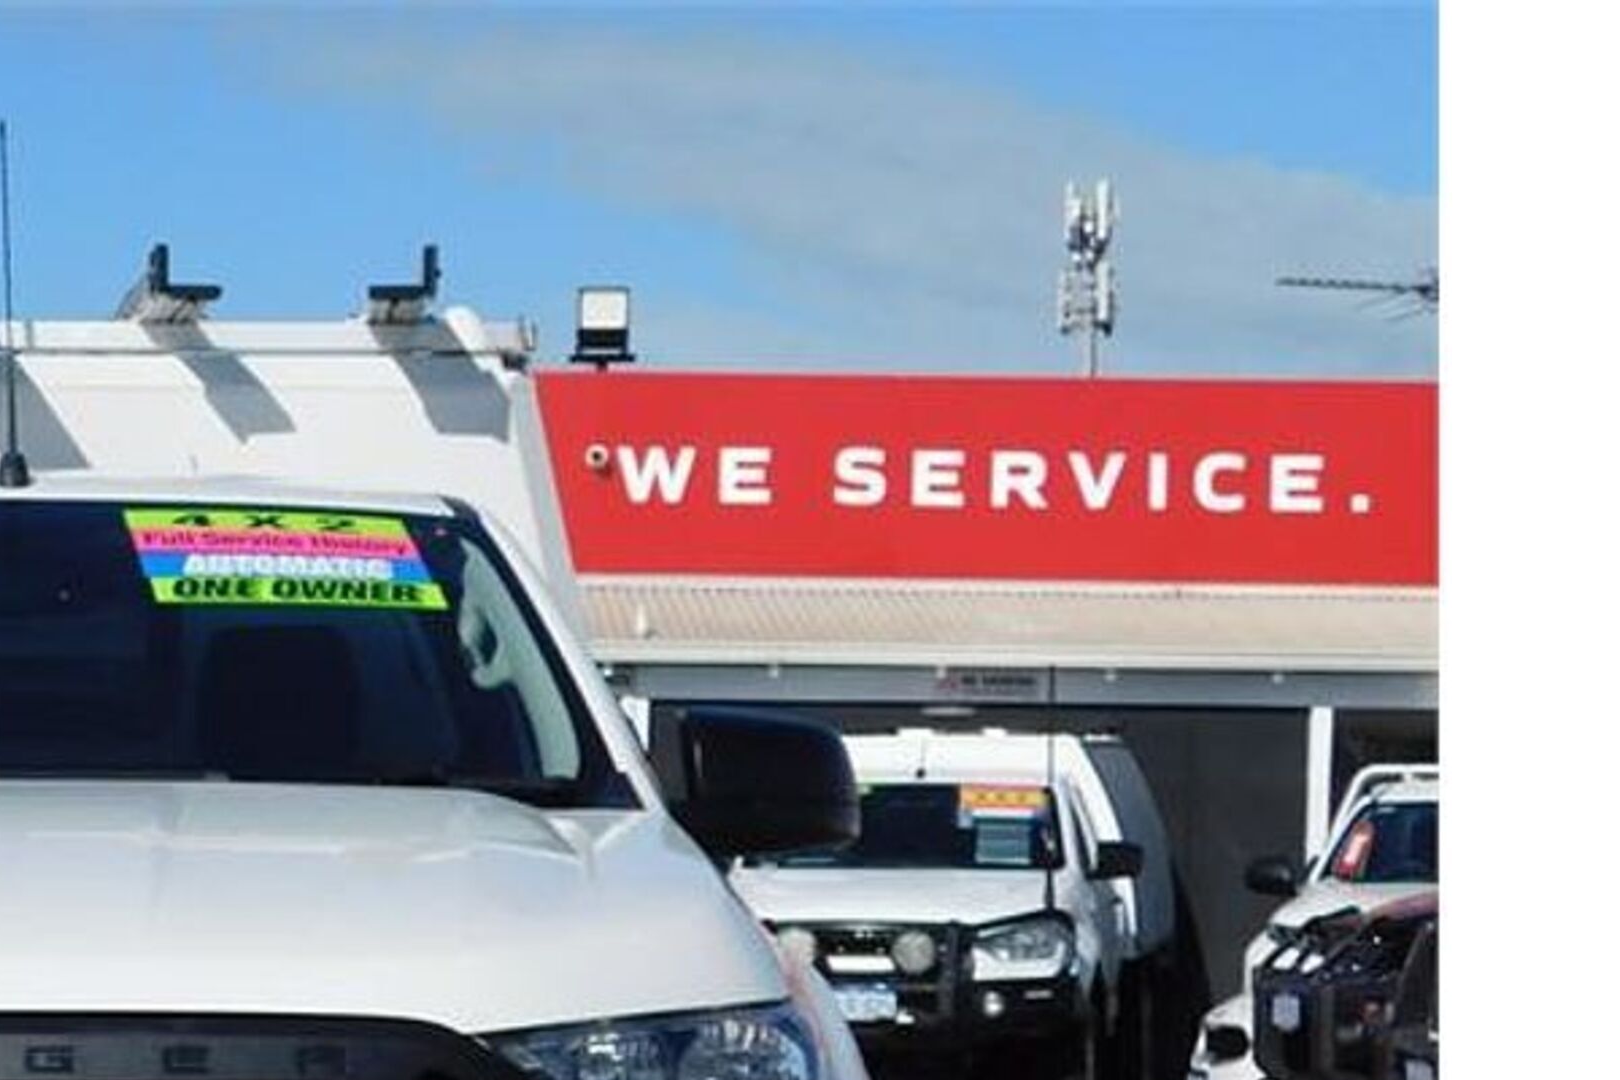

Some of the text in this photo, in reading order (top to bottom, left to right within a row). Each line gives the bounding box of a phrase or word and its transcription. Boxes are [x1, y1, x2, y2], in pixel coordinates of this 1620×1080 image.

[616, 444, 1371, 513] WE SERVICE.
[201, 532, 304, 550] Service
[310, 534, 411, 555] History
[183, 553, 392, 579] AUTOMATIC
[173, 579, 422, 602] ONE OWNER
